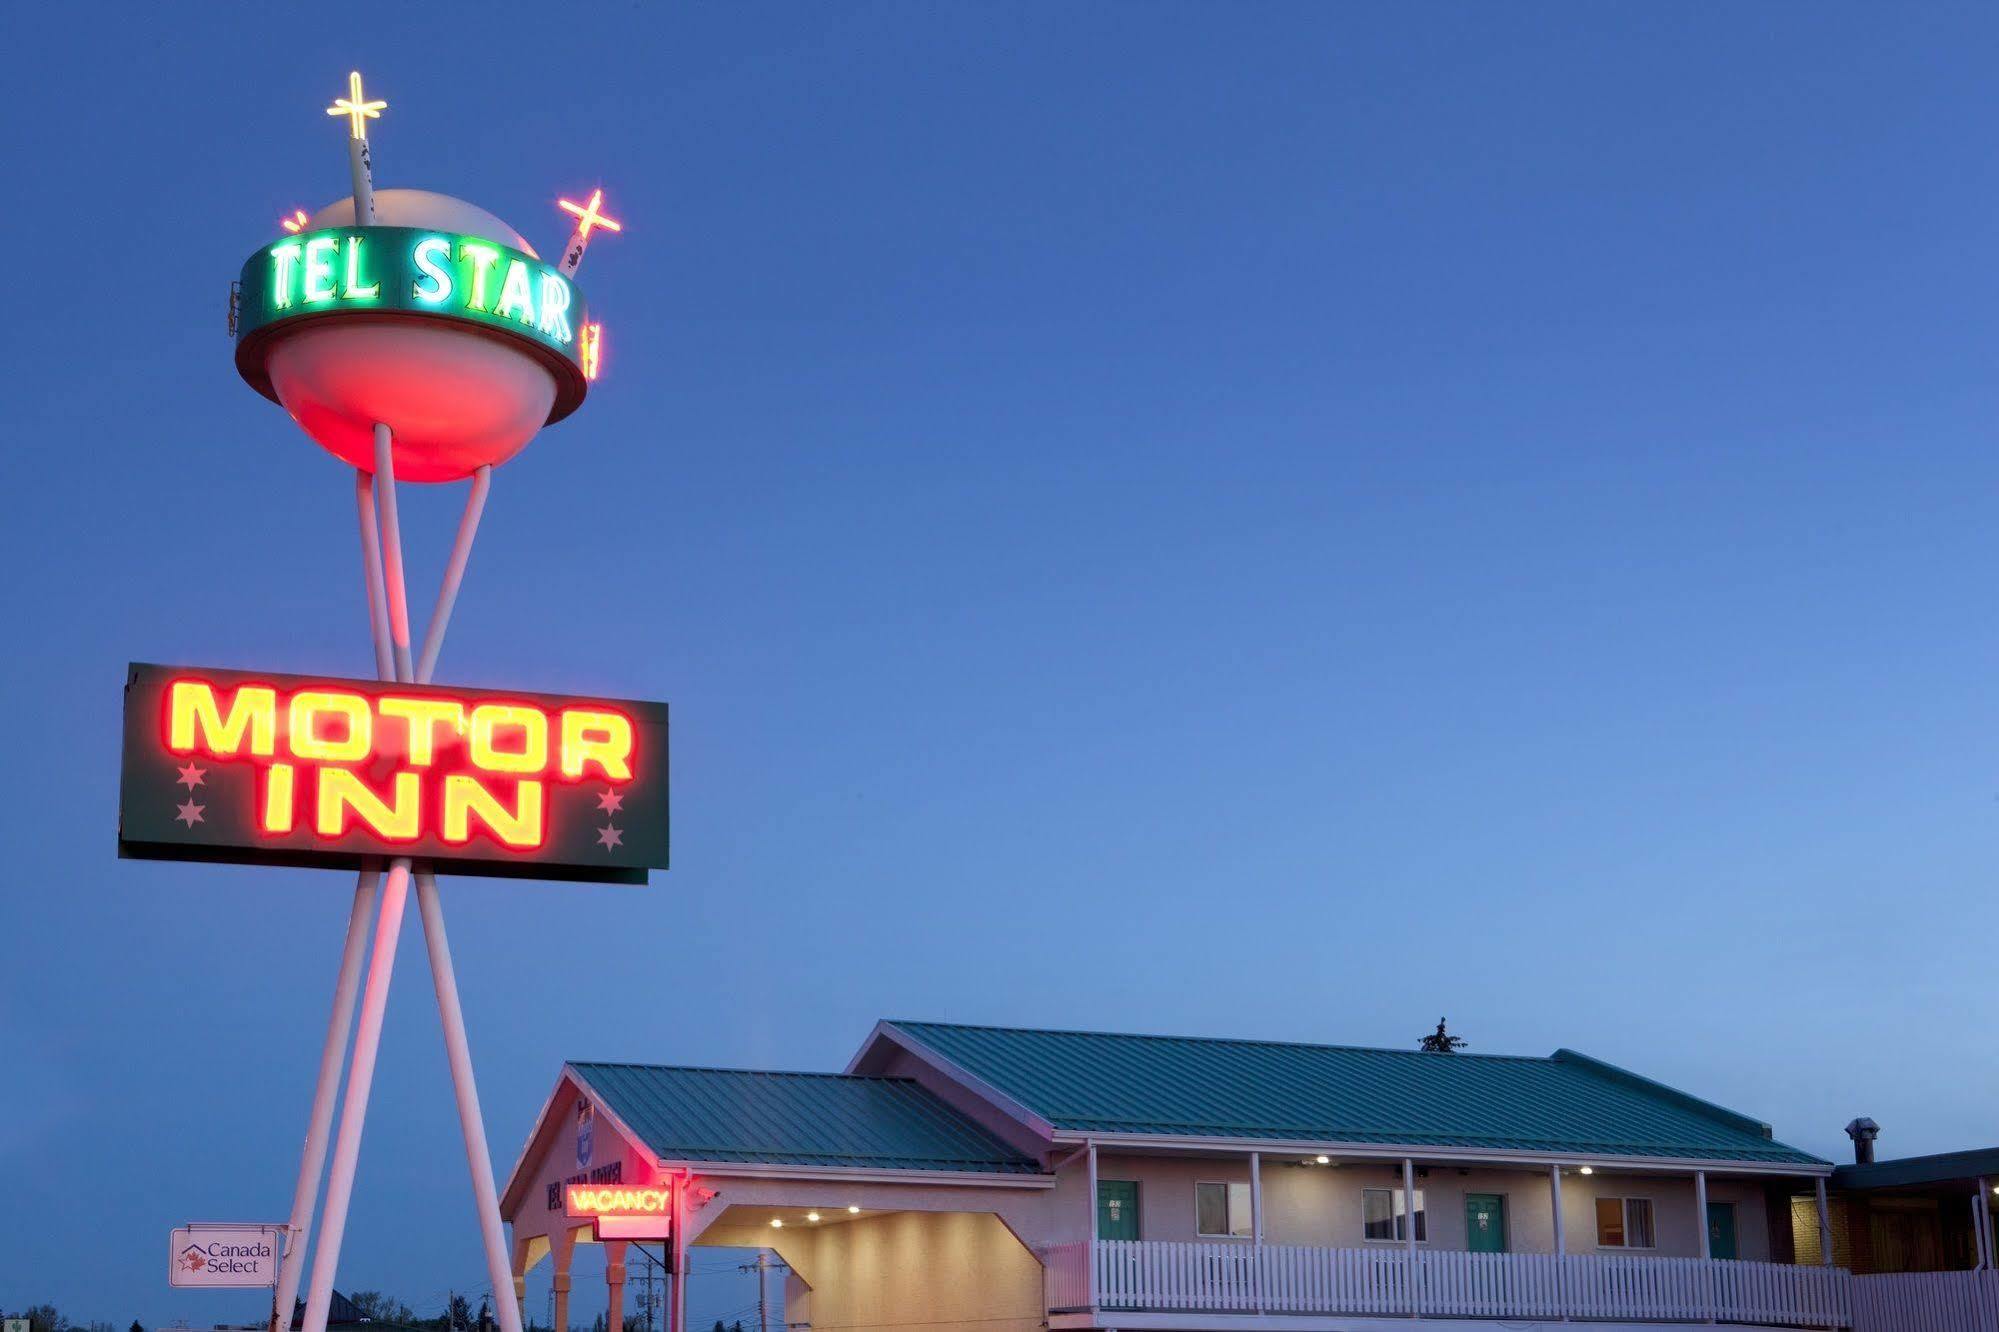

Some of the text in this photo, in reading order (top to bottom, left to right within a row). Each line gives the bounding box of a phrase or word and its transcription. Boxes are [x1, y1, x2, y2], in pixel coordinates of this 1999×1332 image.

[271, 235, 573, 345] TEL STAR
[170, 682, 634, 781] MOTOR
[264, 763, 542, 847] INN
[571, 1190, 669, 1212] VACANCY
[207, 1242, 271, 1257] Canada
[207, 1258, 259, 1273] Select
